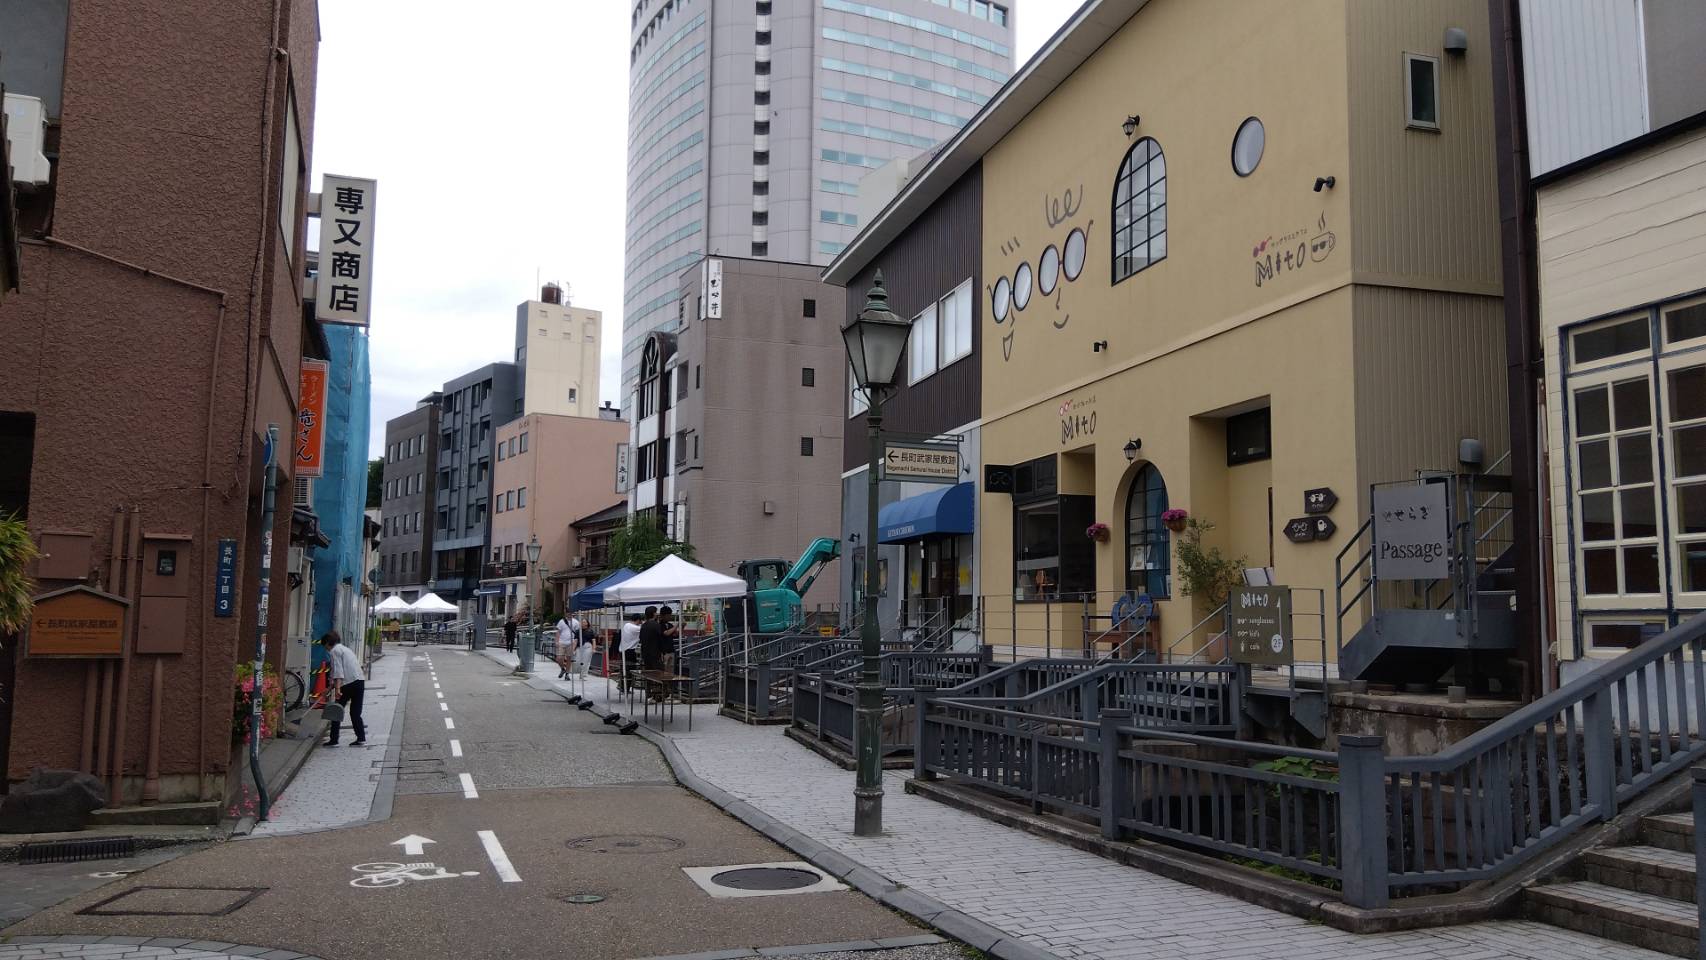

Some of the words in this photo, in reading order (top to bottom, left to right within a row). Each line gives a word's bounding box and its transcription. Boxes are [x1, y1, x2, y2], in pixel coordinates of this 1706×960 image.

[329, 187, 364, 313] 専又商店
[901, 452, 957, 465] 長町武家屋敷跡
[910, 465, 928, 473] Samurai
[1382, 505, 1430, 522] せせらぎ
[1380, 541, 1443, 563] Passage
[222, 546, 233, 594] 長町一丁目
[220, 599, 229, 610] 3
